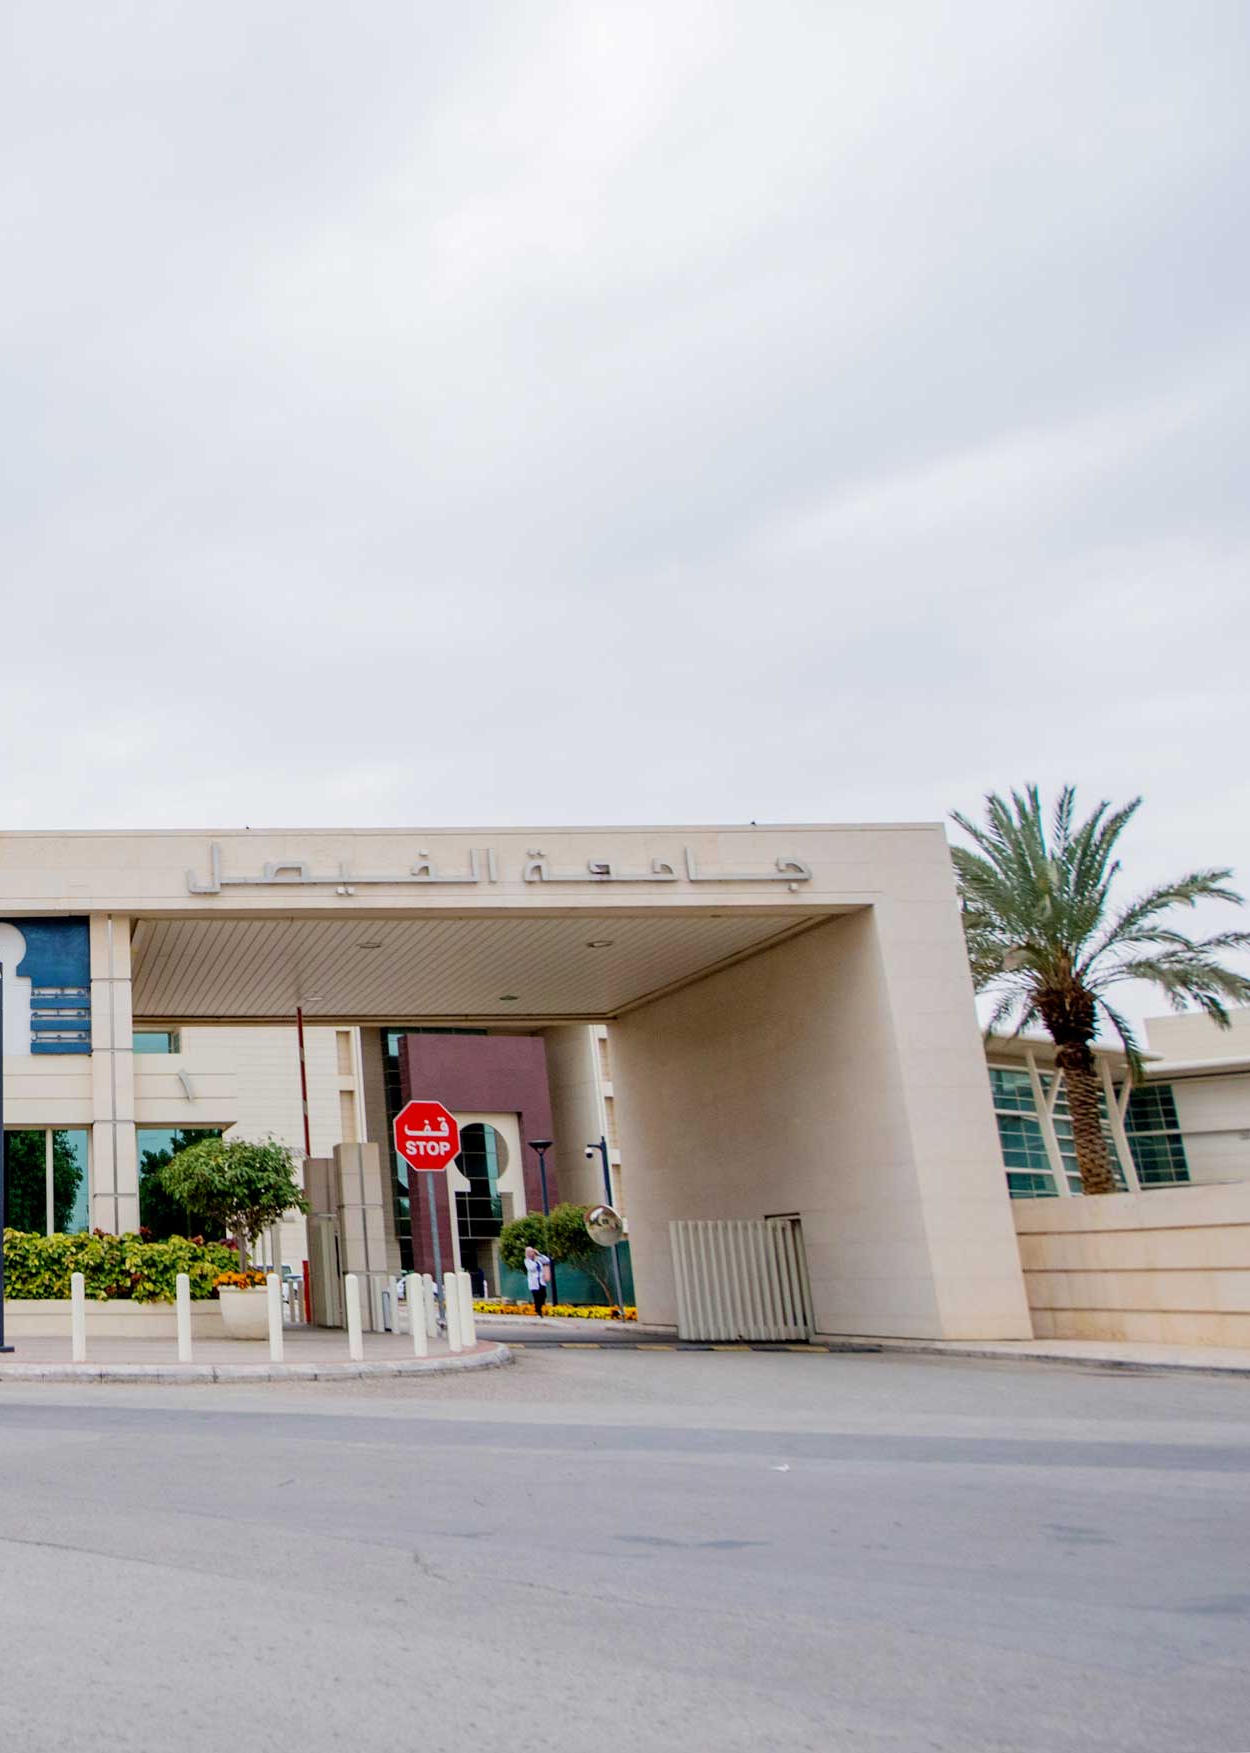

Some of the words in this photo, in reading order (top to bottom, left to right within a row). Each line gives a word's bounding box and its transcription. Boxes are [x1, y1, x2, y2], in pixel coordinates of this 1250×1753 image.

[187, 841, 497, 895] الفيصل
[523, 846, 812, 893] جامعة
[404, 1117, 449, 1137] قف
[405, 1140, 451, 1156] STOP
